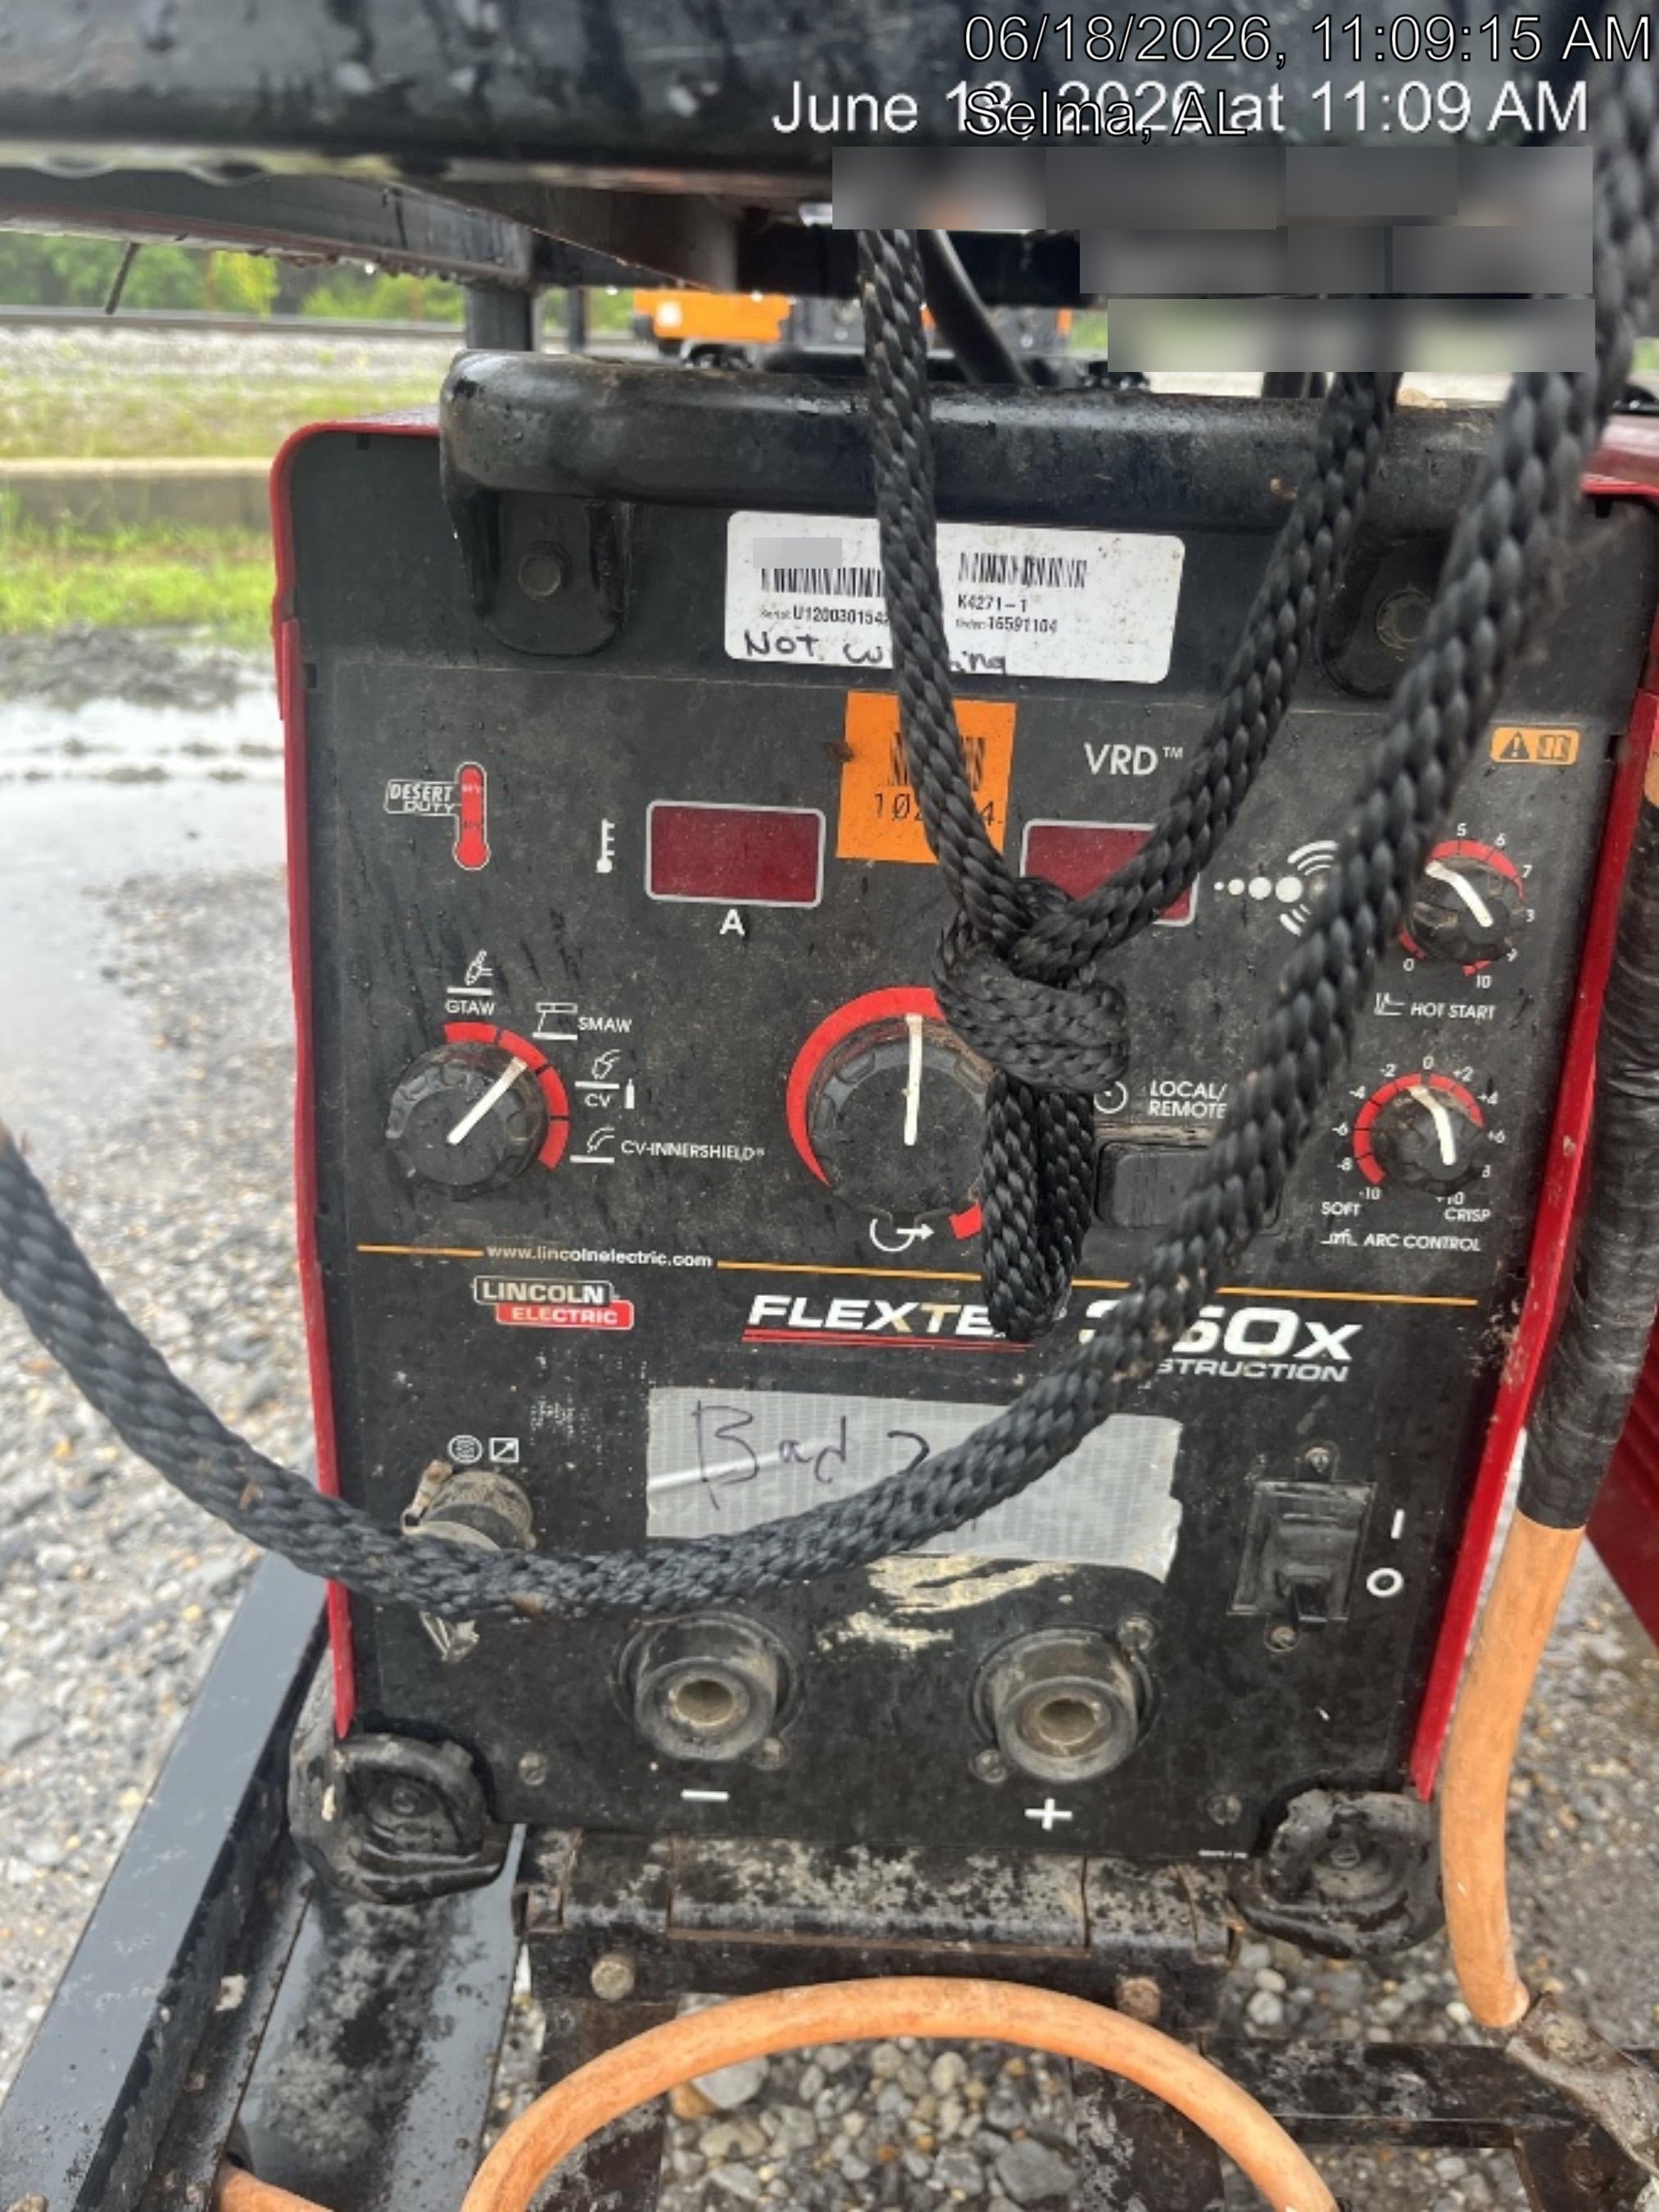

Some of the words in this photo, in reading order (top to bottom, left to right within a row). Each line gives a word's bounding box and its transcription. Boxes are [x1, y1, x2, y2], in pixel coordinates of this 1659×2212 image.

[389, 783, 454, 803] DESERT
[1457, 822, 1467, 837] 5
[1494, 832, 1506, 846] 6
[1521, 863, 1533, 879] 7
[719, 909, 746, 936] A
[1475, 975, 1492, 990] 10
[444, 999, 496, 1016] GTAW
[1410, 1002, 1446, 1018] HOT
[1448, 1004, 1496, 1020] START
[577, 1016, 633, 1034] SMAW
[1380, 1063, 1397, 1078] -2
[1453, 1067, 1474, 1082] +2
[1149, 1079, 1228, 1102] LOCAL/
[1349, 1086, 1366, 1099] -4
[1477, 1091, 1498, 1105] +4
[584, 1092, 612, 1108] CV
[1149, 1099, 1228, 1120] REMOTE
[1331, 1122, 1349, 1136] -6
[1487, 1130, 1506, 1144] +6
[1358, 1187, 1381, 1201] -10
[1321, 1201, 1362, 1217] SOFT
[1444, 1207, 1491, 1223] CRISP
[1364, 1233, 1400, 1248] ARC
[1403, 1235, 1481, 1252] CONTROL
[486, 1244, 713, 1267] www.lincolnelectric.com
[483, 1280, 605, 1304] LINCOLN
[511, 1306, 618, 1324] ELECTRIC
[747, 1294, 1006, 1338] FLEXTE
[1156, 1357, 1349, 1383] STRUCTION
[690, 1400, 847, 1511] Bad
